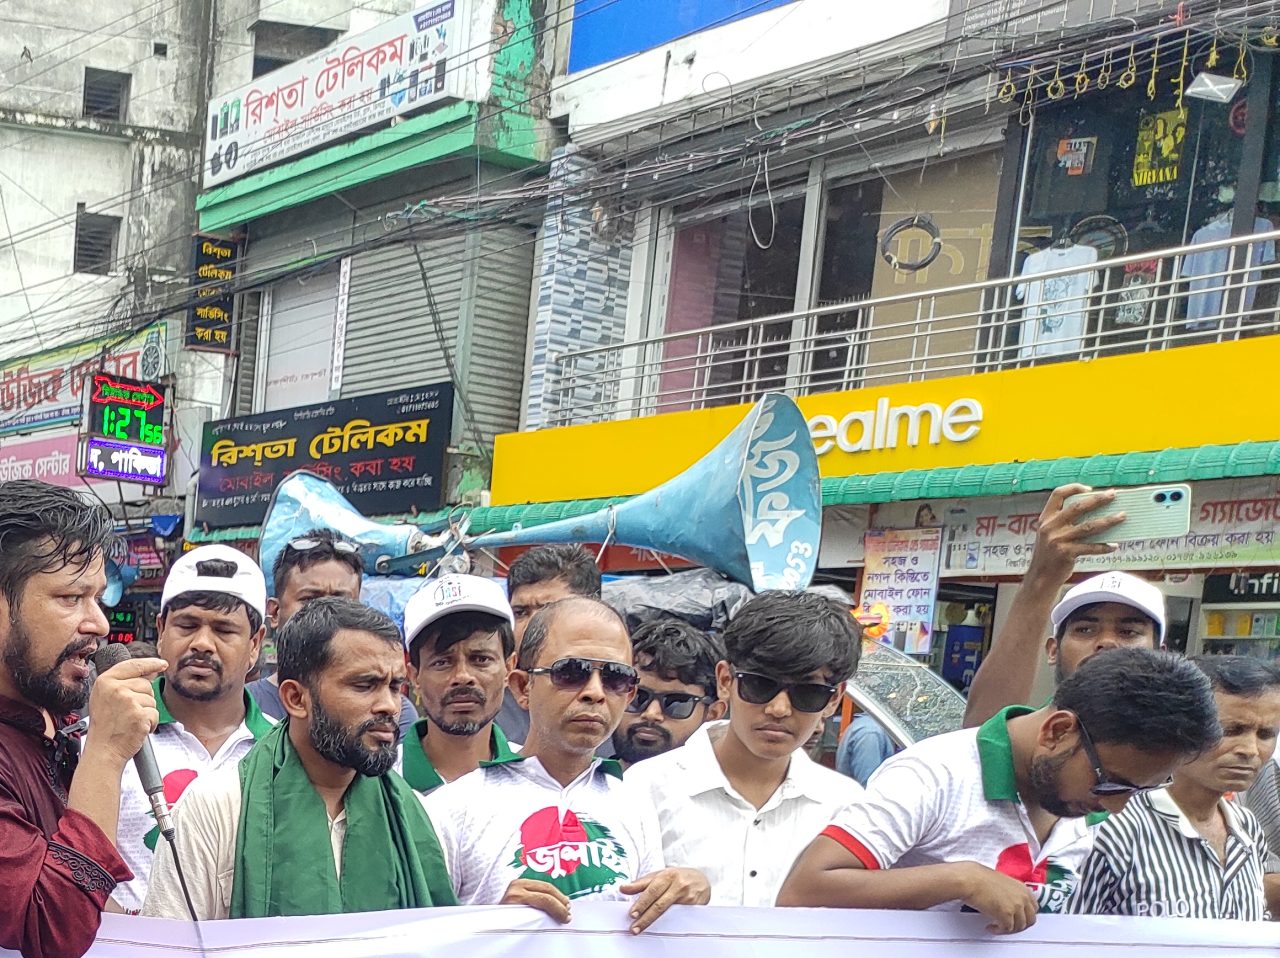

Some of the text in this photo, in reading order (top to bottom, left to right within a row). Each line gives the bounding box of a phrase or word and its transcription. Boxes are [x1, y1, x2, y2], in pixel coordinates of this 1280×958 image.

[314, 33, 408, 99] টেলিকম
[1132, 166, 1178, 187] NIRVANA
[198, 263, 232, 280] টেলিকম
[806, 397, 983, 455] ealme
[309, 418, 430, 459] টেলিকম
[35, 450, 71, 477] সেন্টার
[882, 556, 919, 567] সহজ ও
[867, 573, 891, 583] নগদ
[863, 586, 931, 600] মোবাইল ফোন
[892, 604, 912, 616] করা
[525, 838, 619, 879] জুলাই
